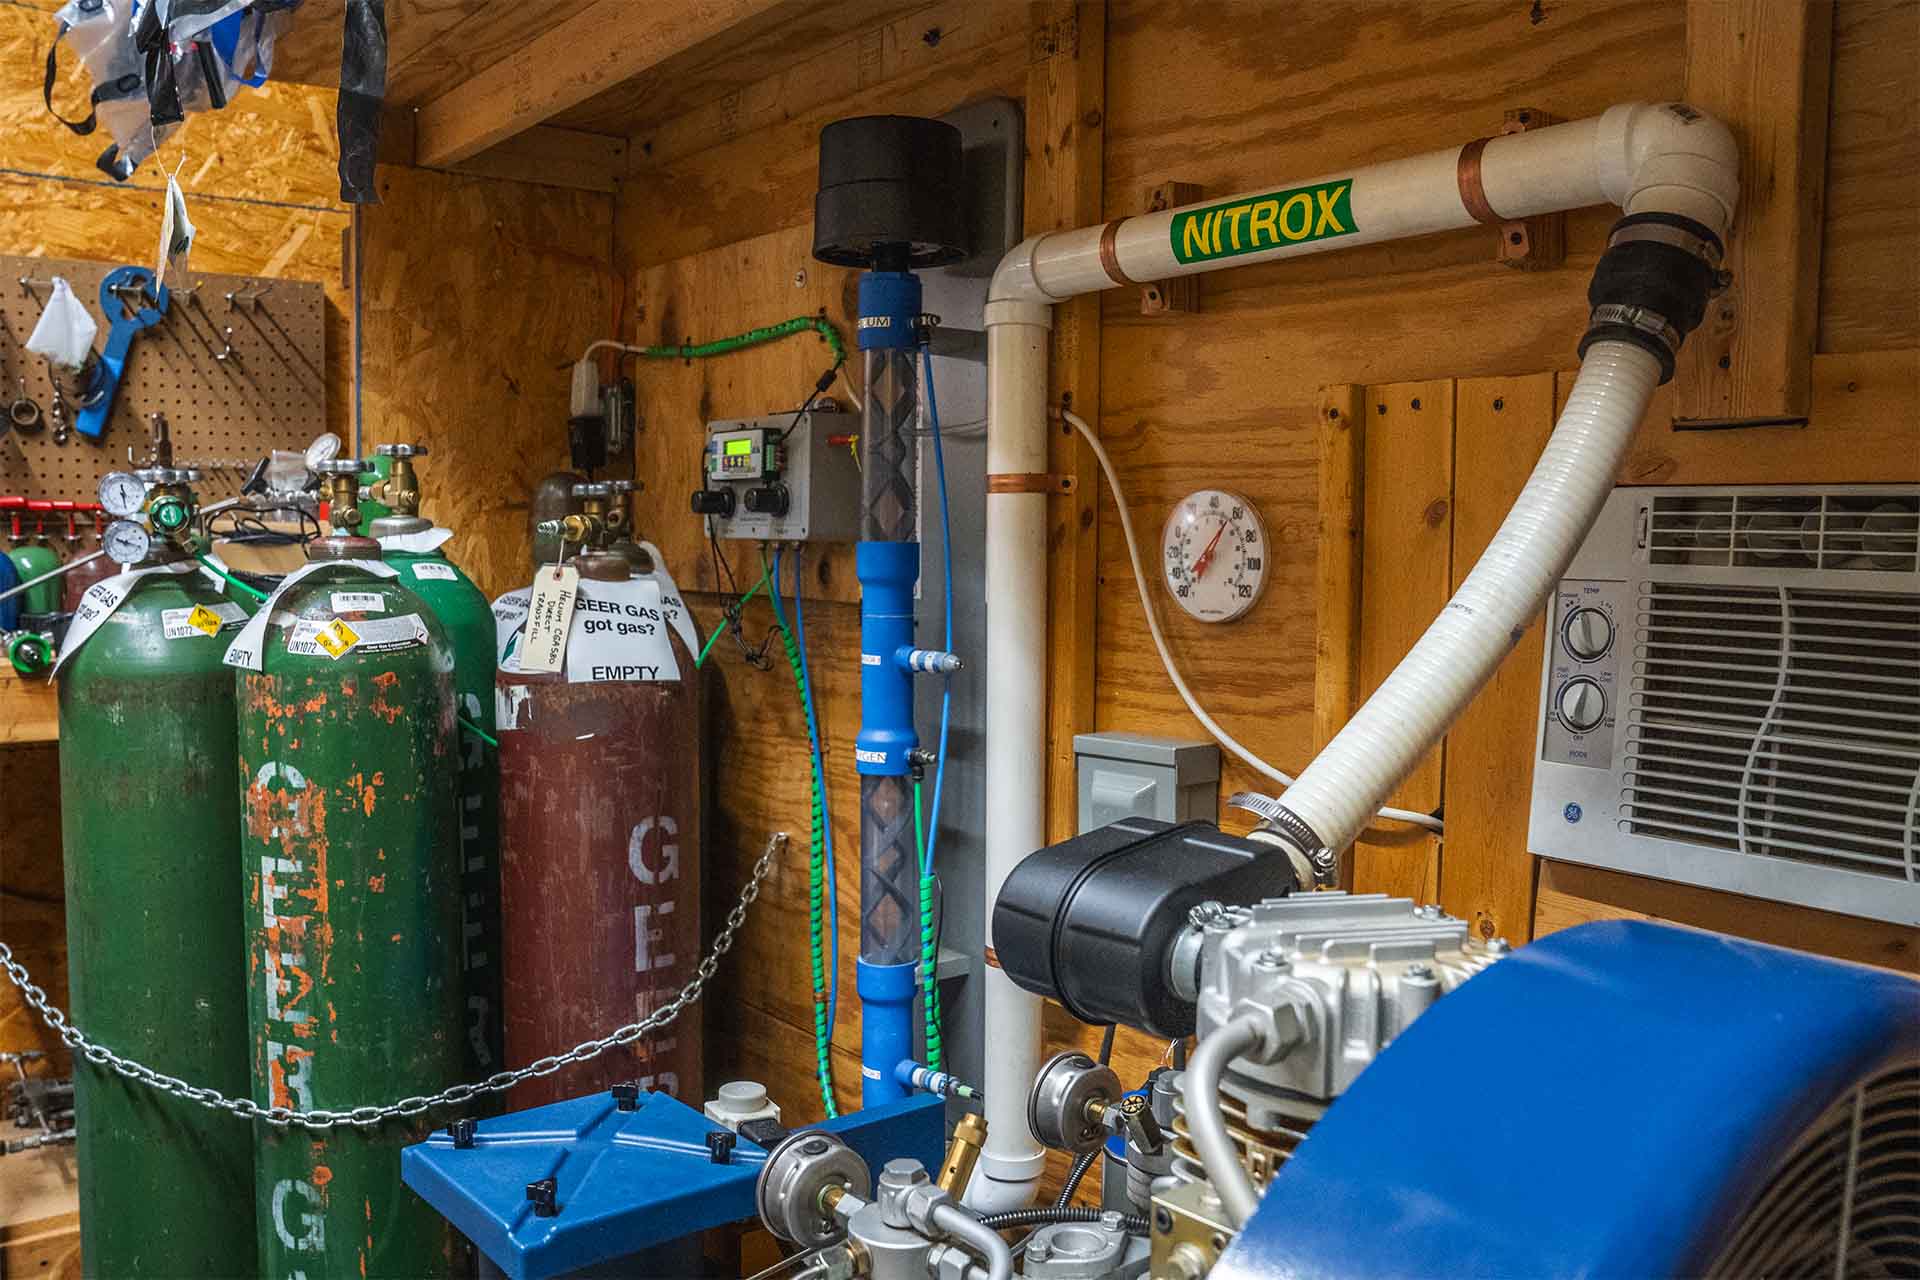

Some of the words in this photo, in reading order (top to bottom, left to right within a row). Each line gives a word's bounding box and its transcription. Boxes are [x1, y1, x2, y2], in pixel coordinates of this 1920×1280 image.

[1183, 185, 1346, 257] NITROX
[1232, 507, 1243, 519] 60
[1246, 529, 1256, 543] 80
[1247, 558, 1261, 570] 100
[1239, 585, 1252, 598] 120
[558, 590, 572, 624] HELIUM
[575, 598, 620, 614] GEER
[626, 604, 660, 621] GAS
[530, 592, 546, 645] TRANSFILL
[166, 625, 193, 637] UN1072
[584, 619, 613, 634] got
[617, 622, 656, 636] gas?
[289, 639, 317, 654] UN1072
[229, 648, 253, 666] EMPTY
[591, 666, 660, 680] EMPTY
